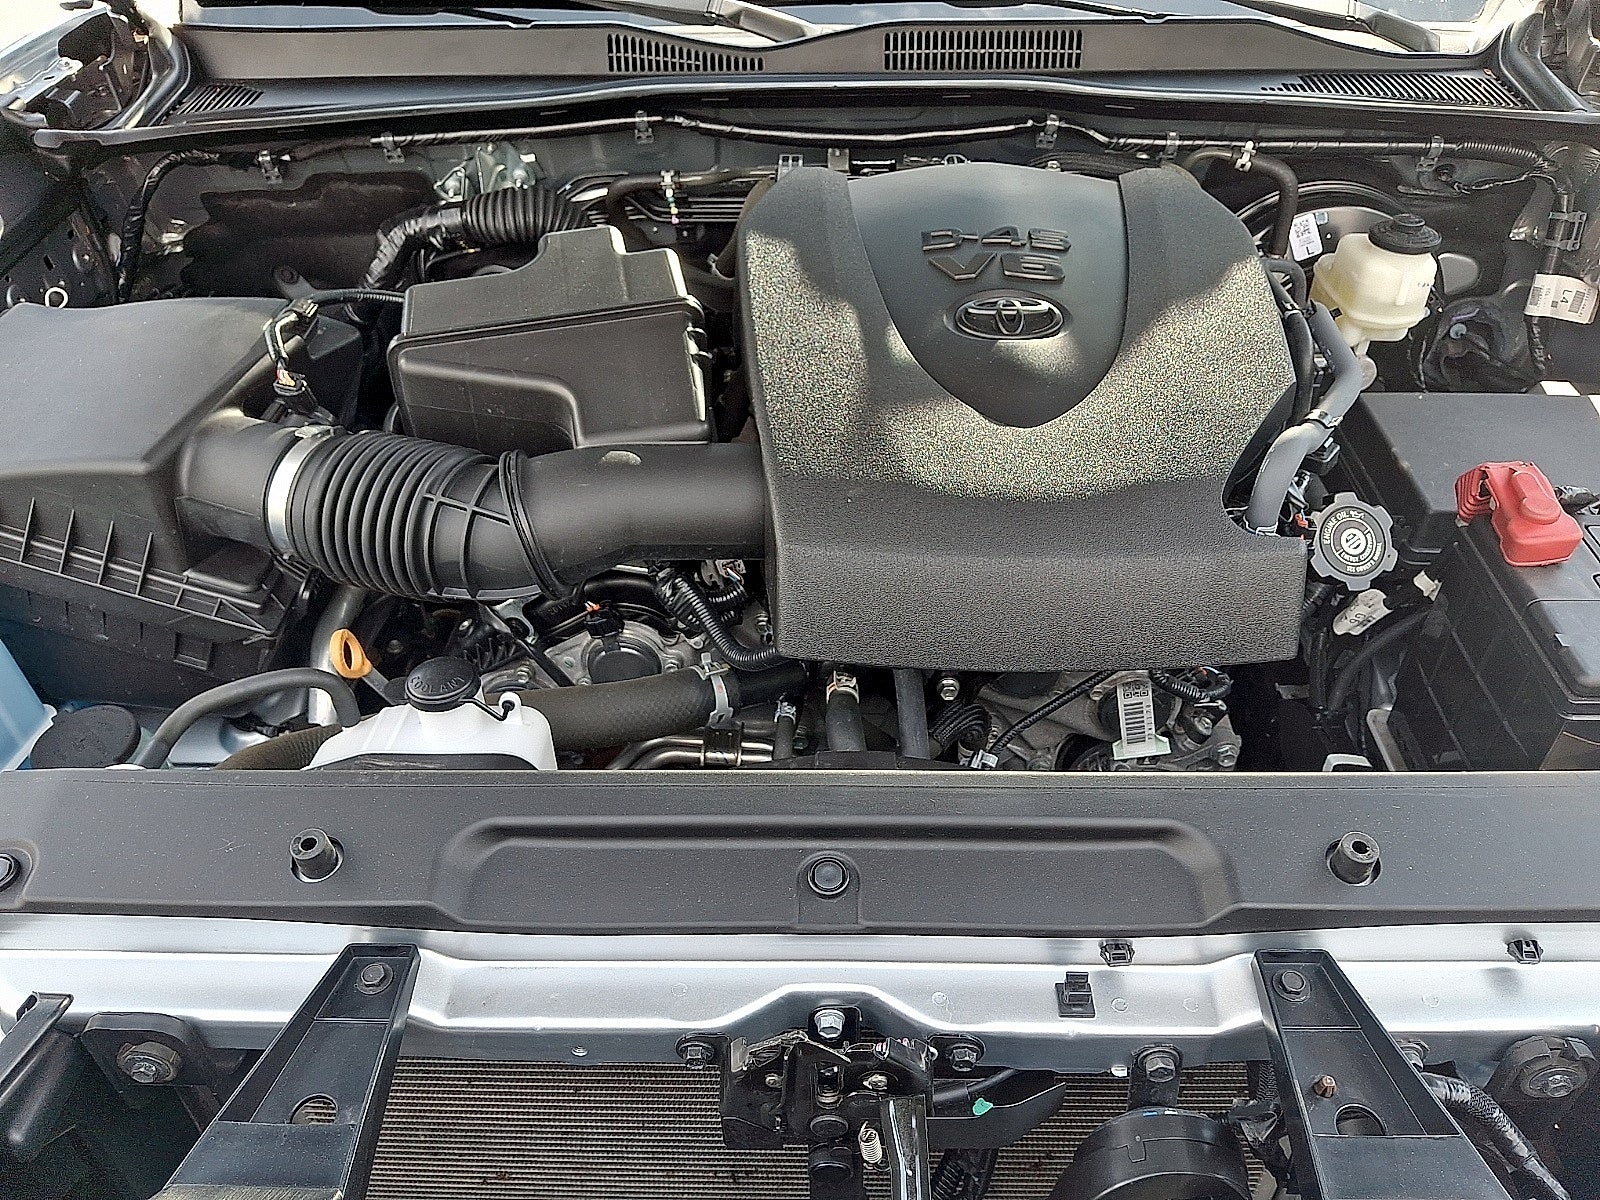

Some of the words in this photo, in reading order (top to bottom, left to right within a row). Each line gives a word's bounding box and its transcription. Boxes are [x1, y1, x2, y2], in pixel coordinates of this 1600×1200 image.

[929, 251, 1065, 281] V6
[1560, 289, 1573, 304] L4
[1323, 514, 1338, 545] ENGINE
[1336, 511, 1350, 520] OIL
